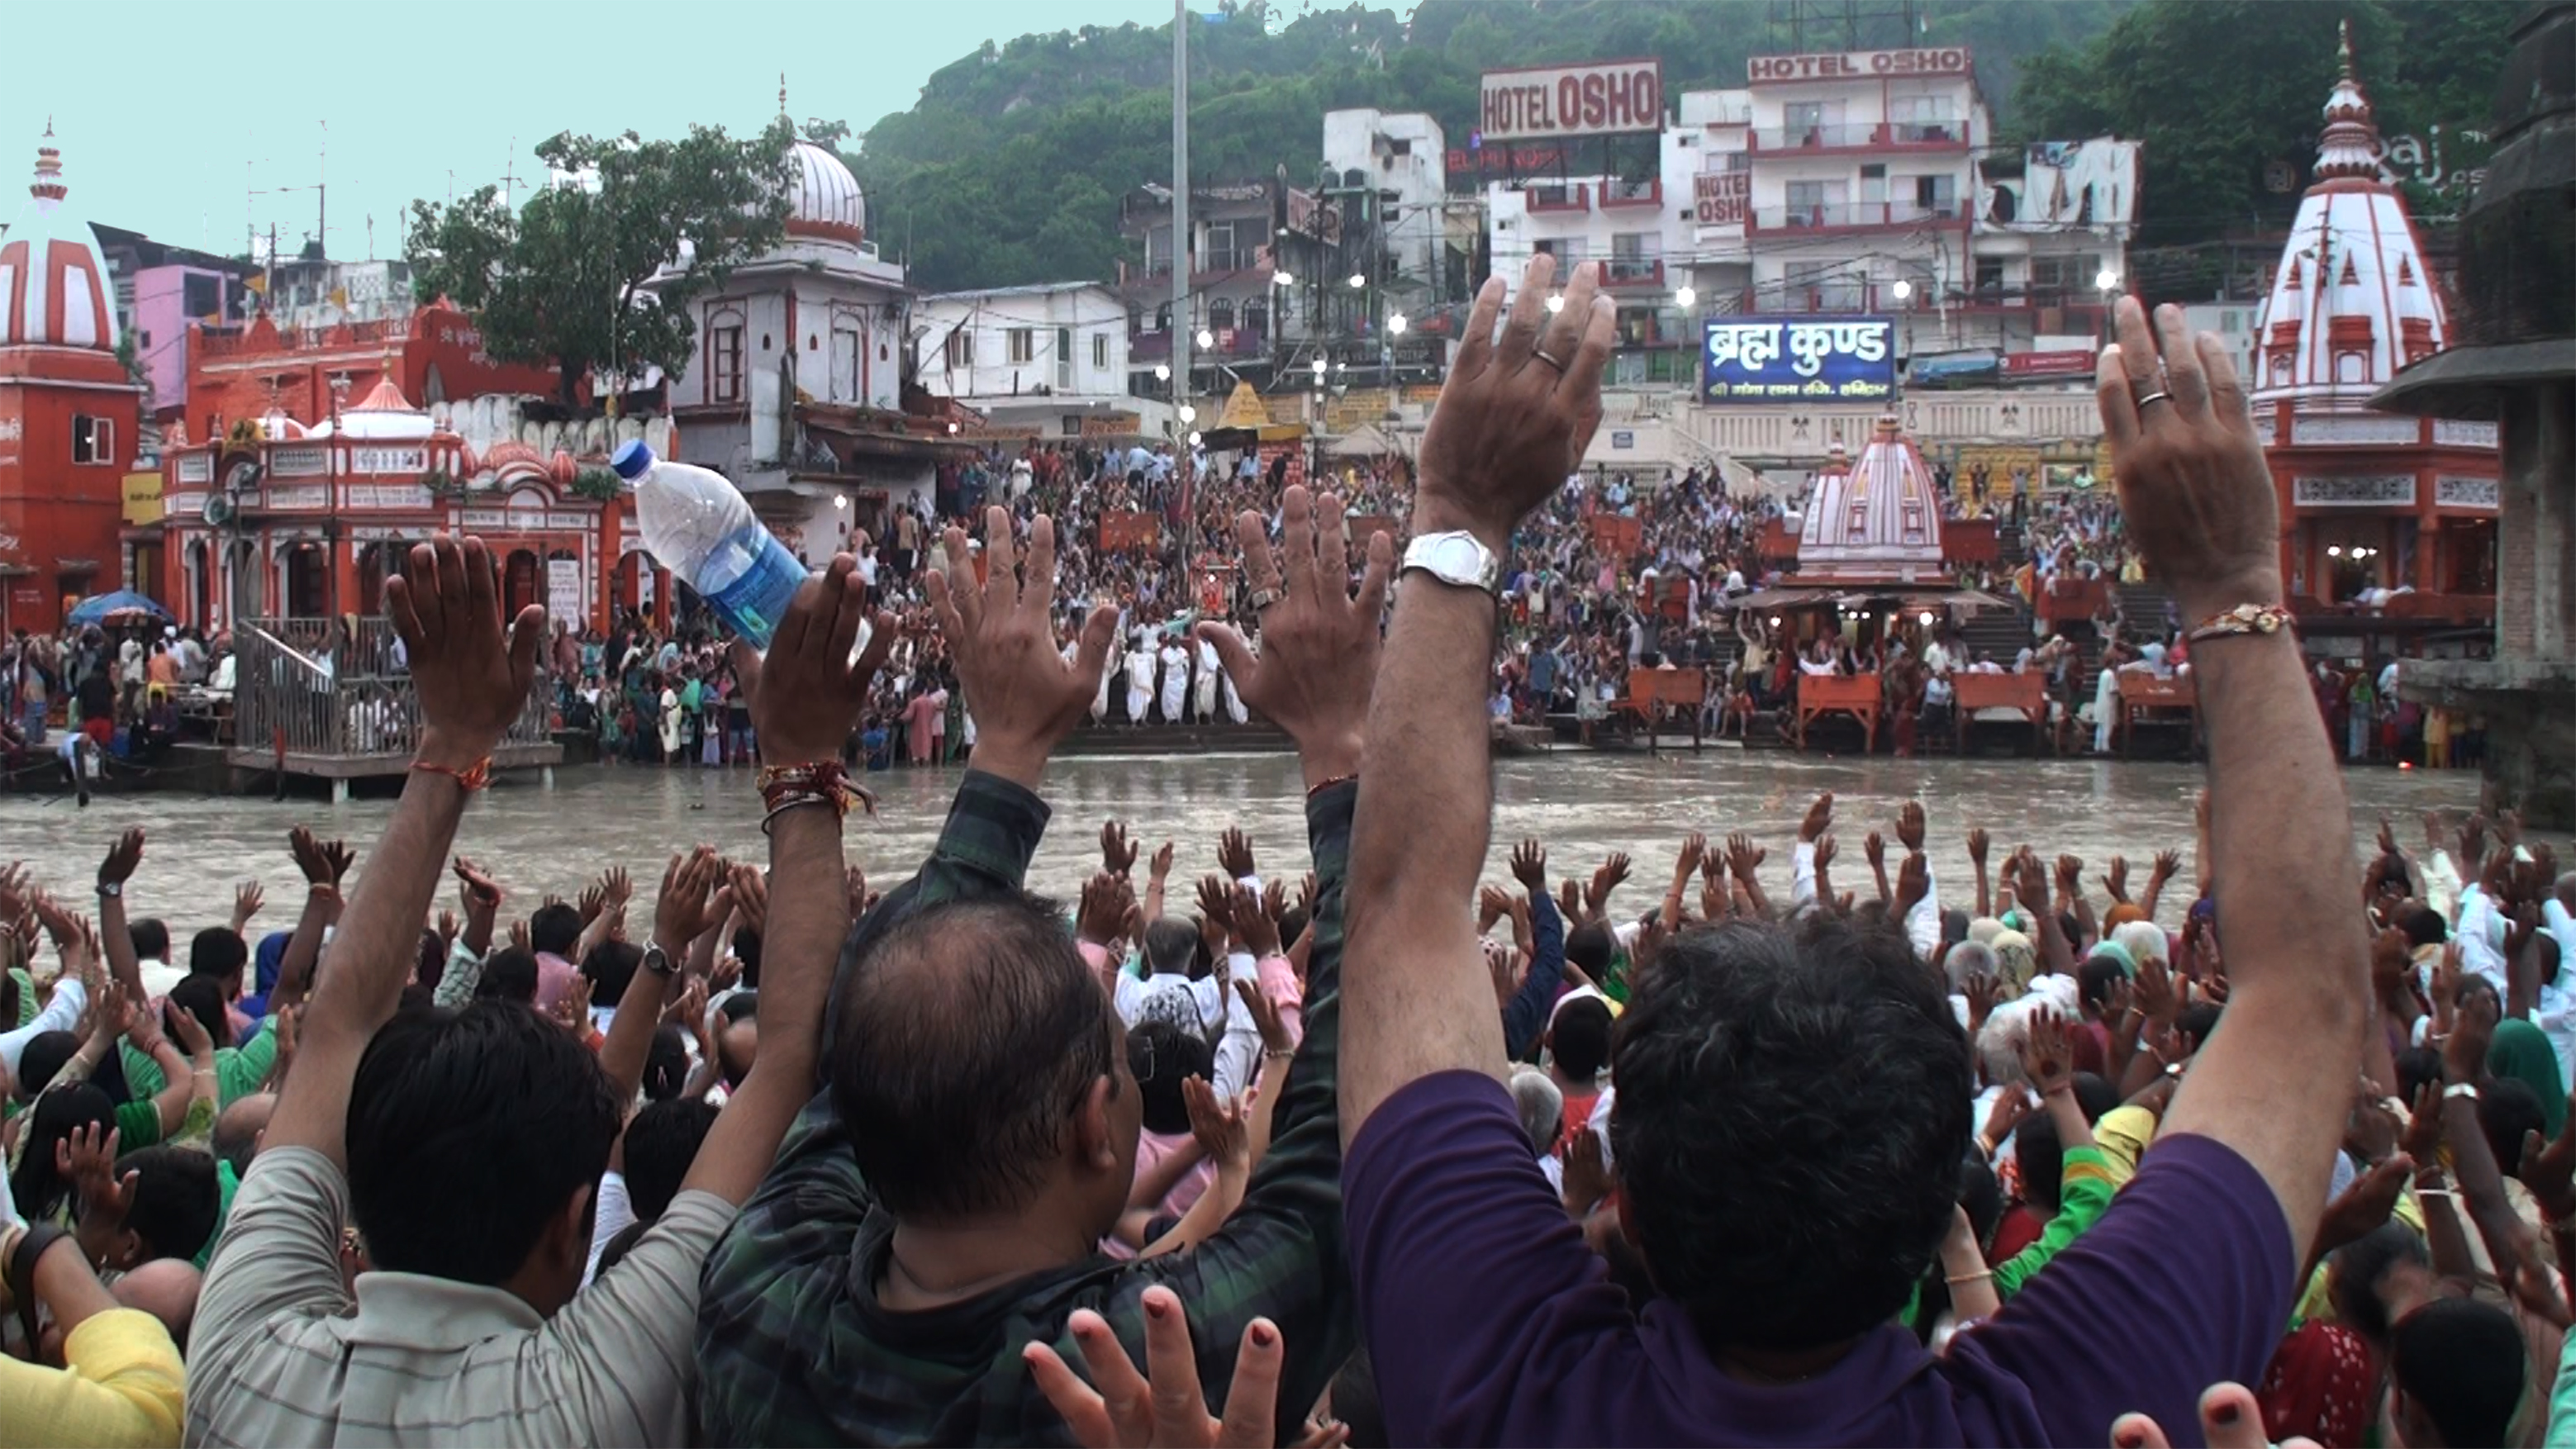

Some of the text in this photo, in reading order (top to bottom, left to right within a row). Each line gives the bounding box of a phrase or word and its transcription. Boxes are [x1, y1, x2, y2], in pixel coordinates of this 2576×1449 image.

[1751, 50, 1962, 78] HOTEL OSHO
[1483, 70, 1656, 133] HOTEL OSHO
[1708, 321, 1889, 377] ब्रह्म कुण्ड
